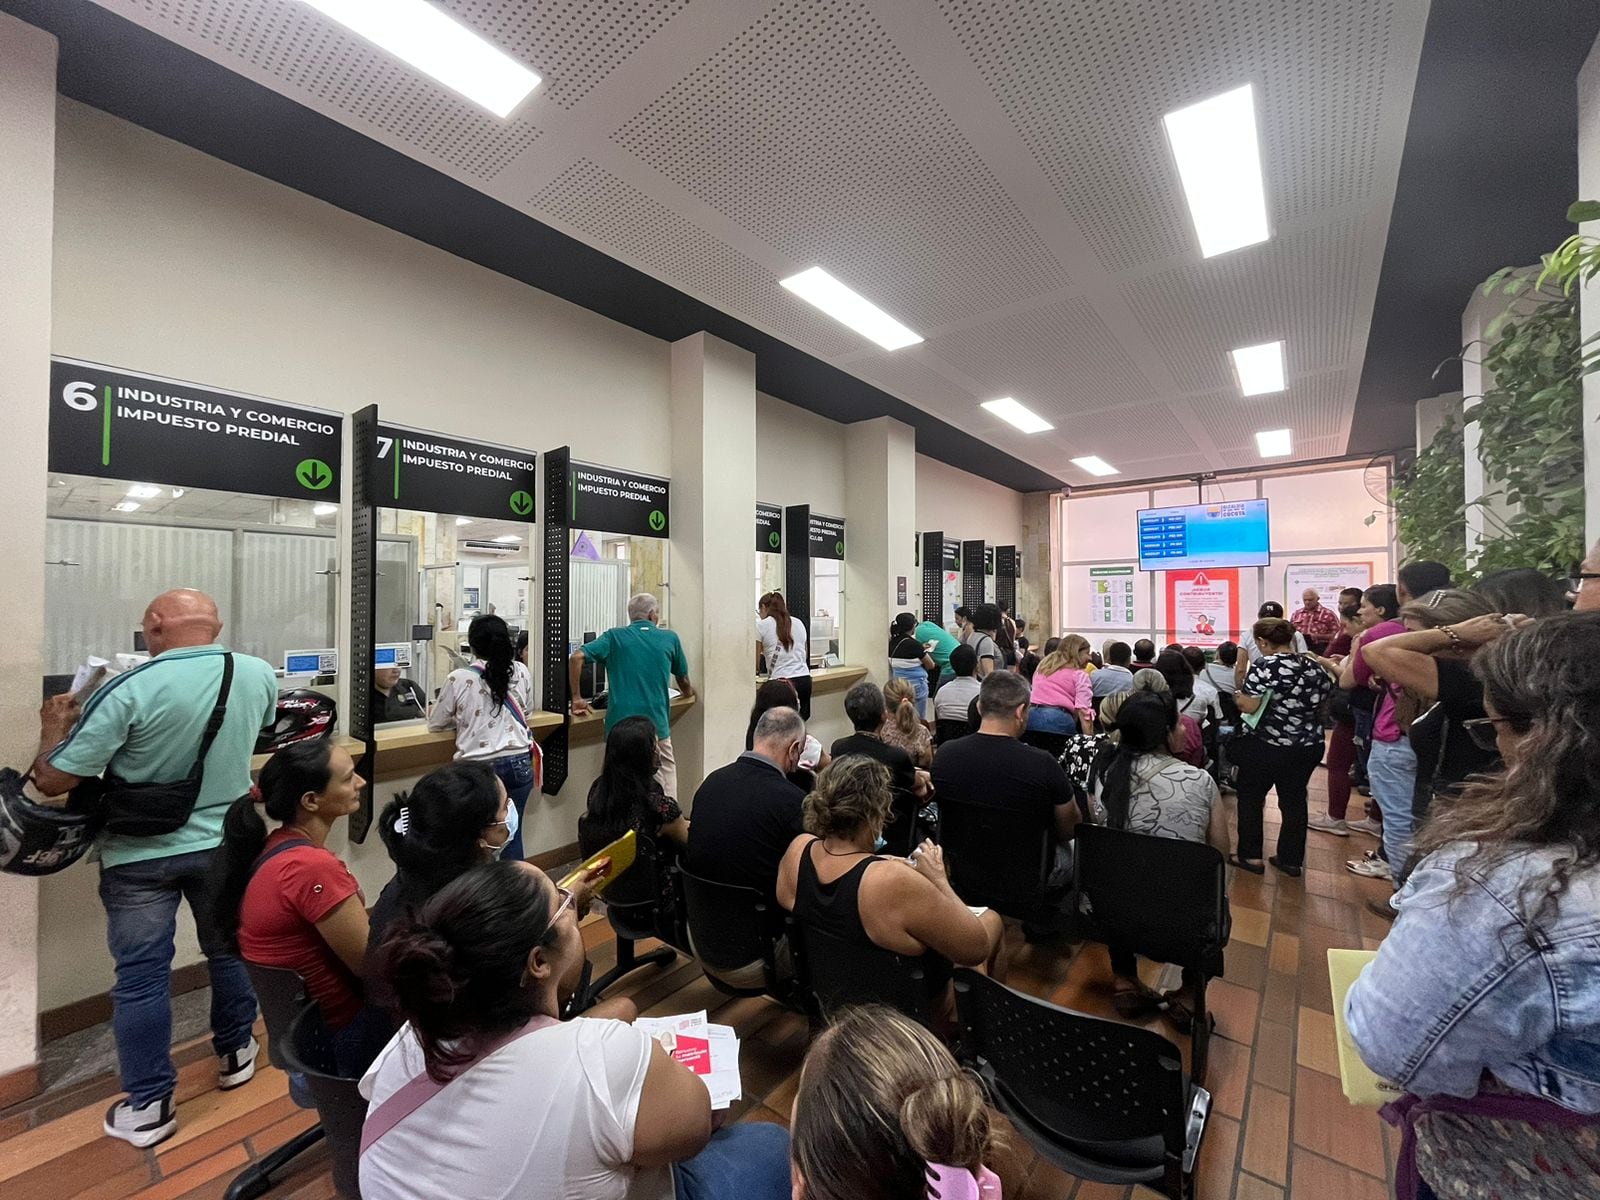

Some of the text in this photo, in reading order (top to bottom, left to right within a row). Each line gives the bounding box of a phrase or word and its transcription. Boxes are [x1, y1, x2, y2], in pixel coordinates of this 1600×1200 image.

[62, 380, 98, 411] 6
[117, 405, 300, 446] IMPUESTO PREDIAL
[118, 386, 335, 436] INDUSTRIA Y COMERCIO
[376, 436, 393, 459] 7
[403, 439, 534, 472] INDUSTRIA Y COMERCIO
[403, 454, 513, 481] IMPUESTO PREDIAL
[578, 472, 621, 486] INDUSTRIA
[628, 481, 666, 494] COMERCIO
[578, 484, 652, 502] IMPUESTO PREDIAL
